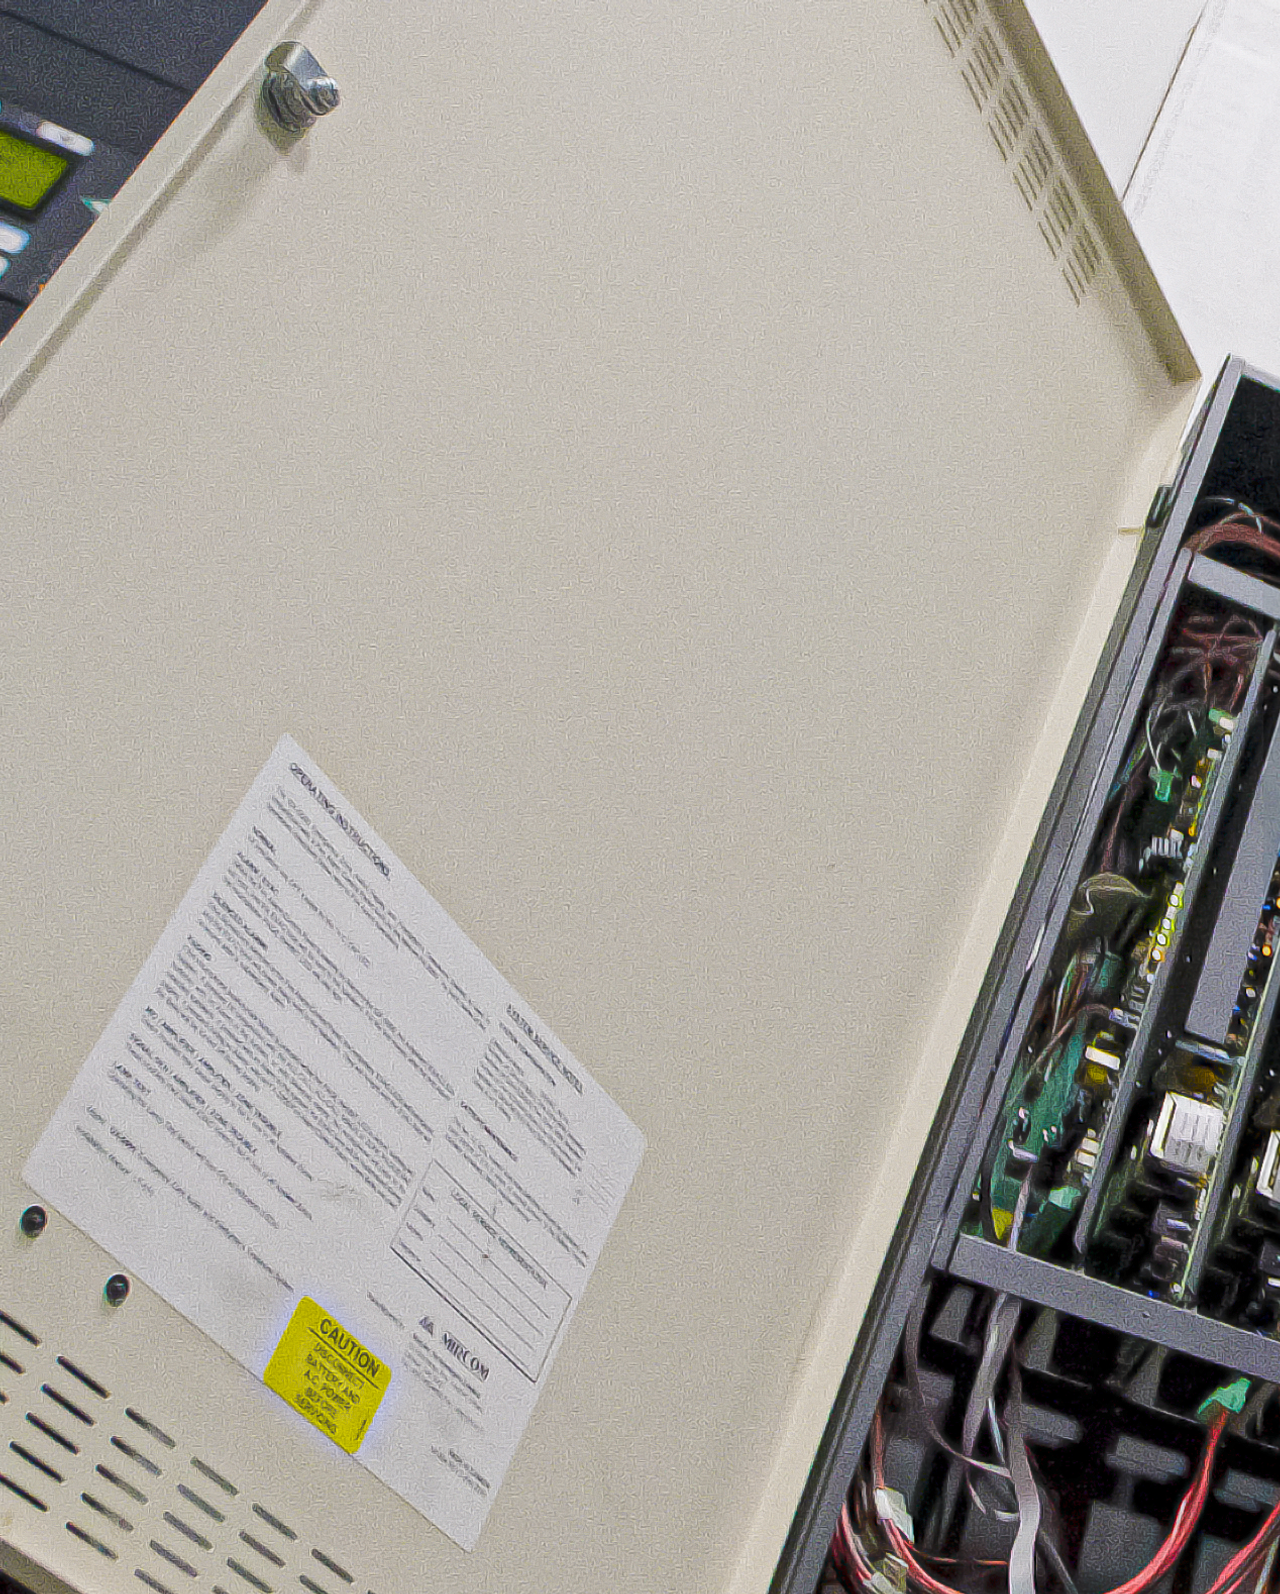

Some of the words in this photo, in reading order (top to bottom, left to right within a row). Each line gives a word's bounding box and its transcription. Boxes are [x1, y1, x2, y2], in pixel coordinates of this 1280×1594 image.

[287, 759, 337, 817] OPERATING
[333, 810, 392, 879] INSTRUCTIONS
[312, 1340, 365, 1392] DISCONNECT
[317, 1315, 380, 1379] CAUTION
[439, 1328, 490, 1384] MIRCOM
[303, 1385, 339, 1420] BEFORE
[304, 1352, 344, 1391] BATTERY
[340, 1383, 361, 1407] AND
[319, 1380, 352, 1414] POWER
[292, 1391, 339, 1436] SERVICING
